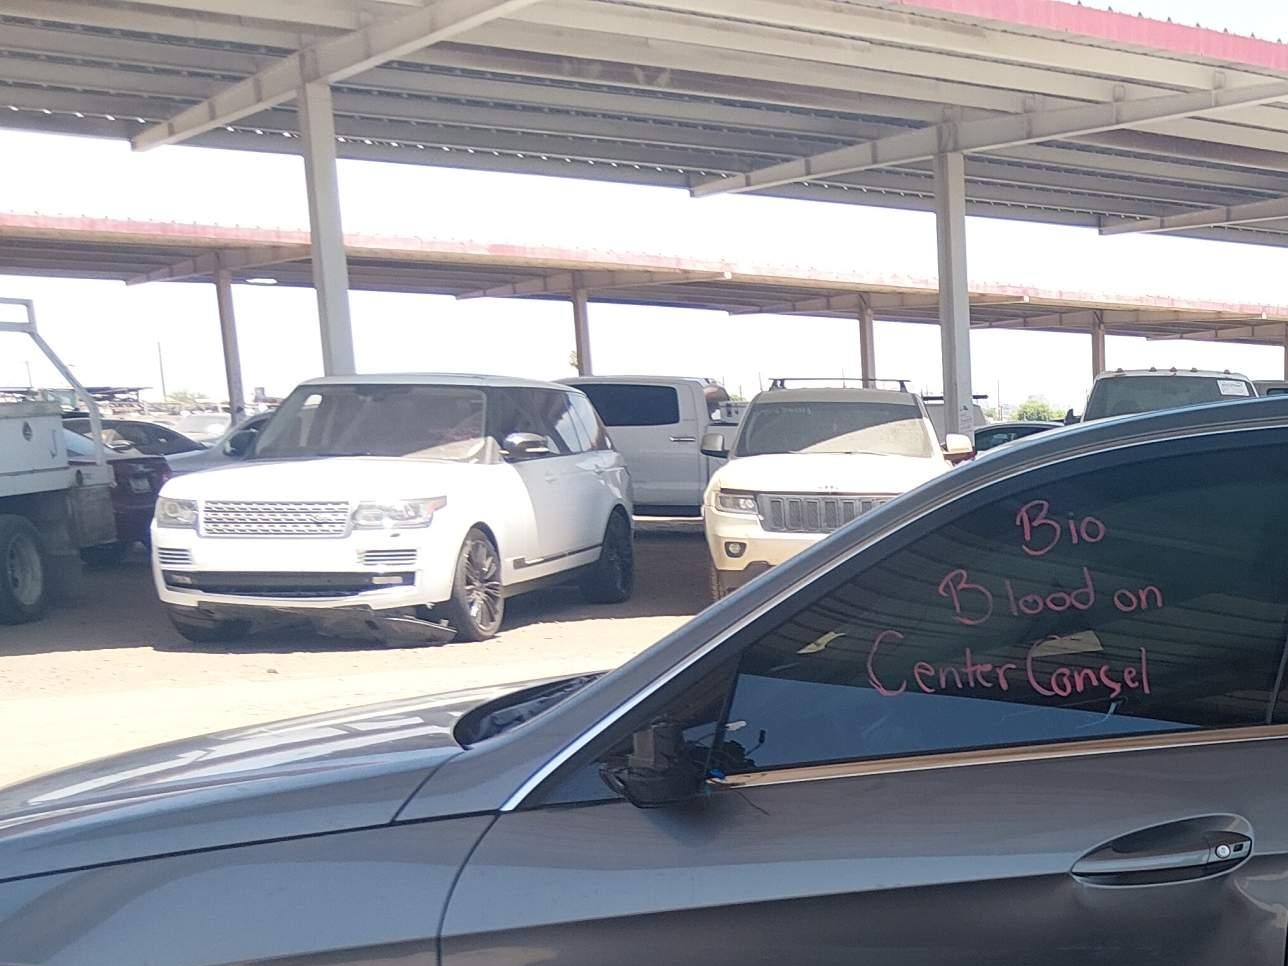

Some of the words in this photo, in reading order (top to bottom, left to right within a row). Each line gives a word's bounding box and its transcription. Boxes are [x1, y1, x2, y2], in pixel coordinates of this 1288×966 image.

[1016, 499, 1106, 556] Bio
[938, 566, 1096, 625] Blood
[1113, 584, 1163, 612] on
[866, 630, 1017, 697] Center
